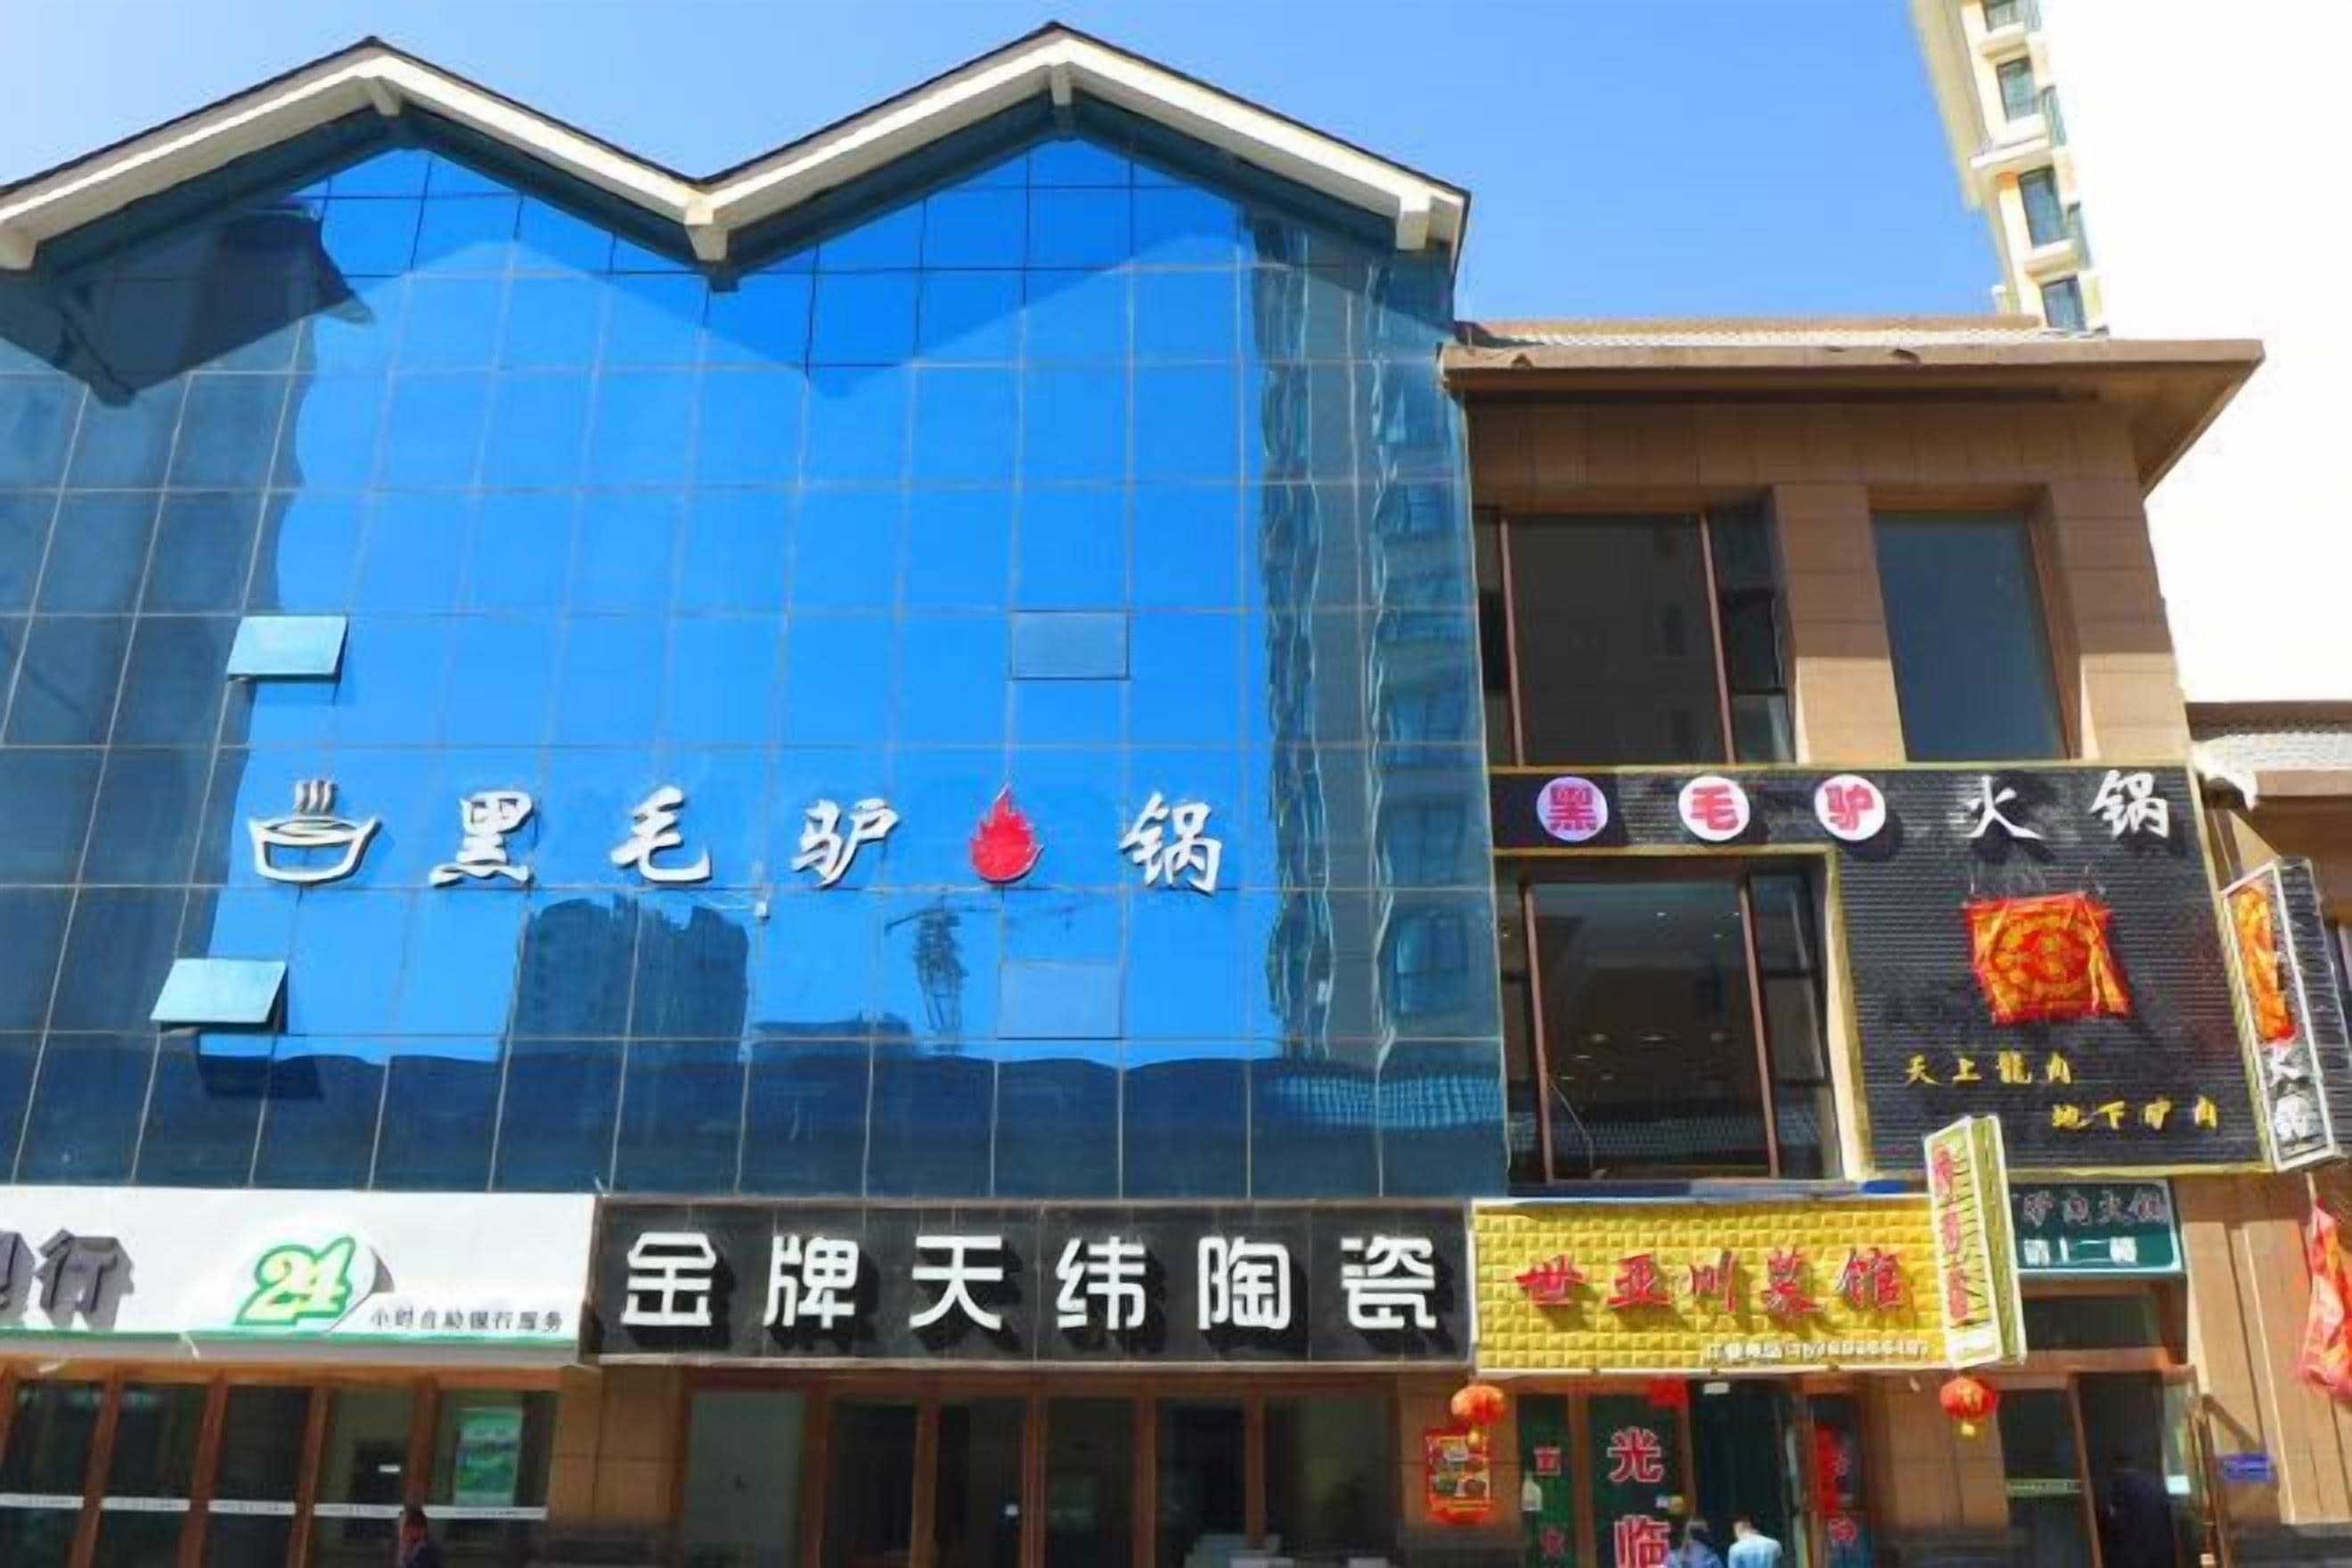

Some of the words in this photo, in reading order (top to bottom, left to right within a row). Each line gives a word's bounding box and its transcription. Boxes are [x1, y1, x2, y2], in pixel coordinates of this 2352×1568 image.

[1547, 772, 2170, 840] 黑毛驴火锅
[238, 1236, 356, 1325] 24
[619, 1231, 1437, 1332] 金牌天纬陶瓷
